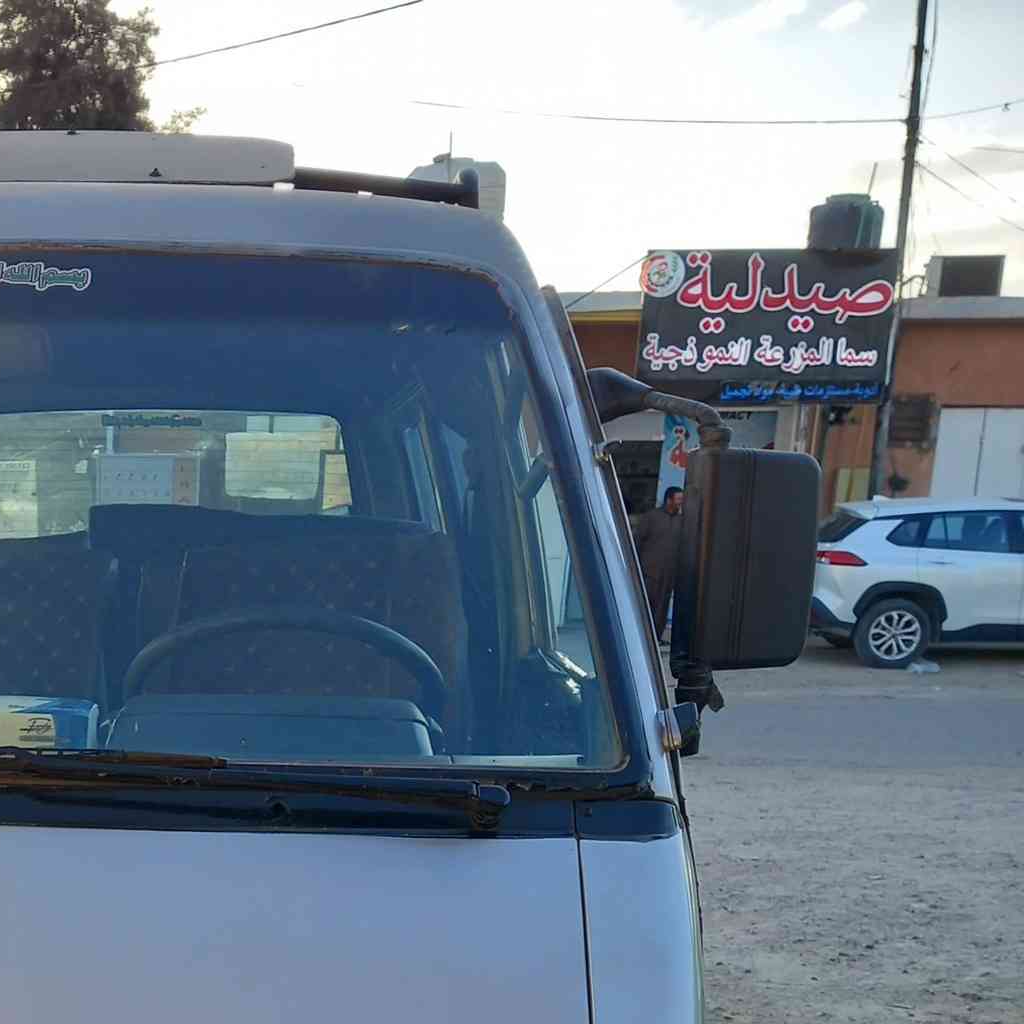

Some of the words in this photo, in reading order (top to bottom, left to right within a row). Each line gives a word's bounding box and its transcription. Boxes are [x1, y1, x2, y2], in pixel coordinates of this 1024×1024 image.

[3, 262, 43, 285] الله
[39, 267, 91, 291] بسم
[677, 250, 894, 333] صيدلية
[754, 335, 833, 373] المزرعة
[837, 337, 877, 366] سما
